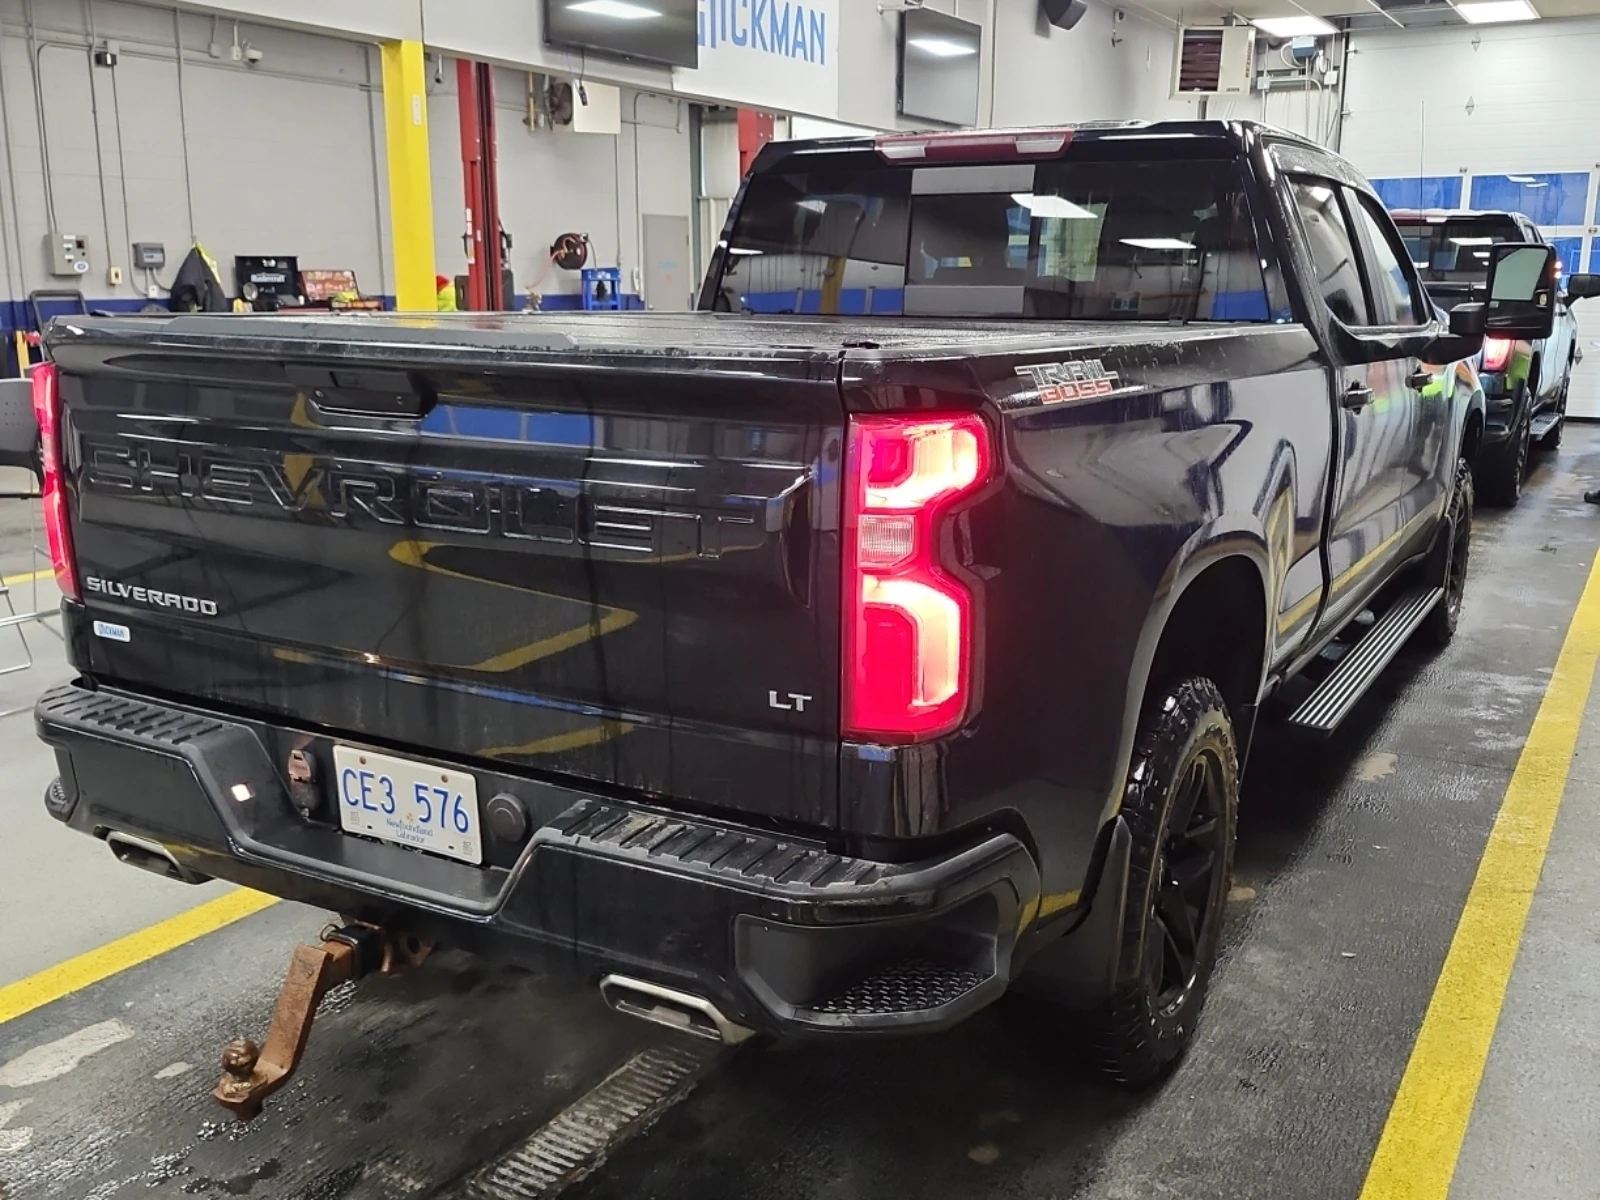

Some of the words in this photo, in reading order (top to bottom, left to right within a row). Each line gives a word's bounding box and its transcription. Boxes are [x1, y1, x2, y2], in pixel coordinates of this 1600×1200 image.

[1014, 359, 1119, 388] TRAIL
[1039, 379, 1113, 404] BOSS
[86, 442, 756, 559] CHEVROLET
[86, 576, 218, 616] SILVERADO
[769, 690, 813, 712] LT
[341, 767, 396, 814] CE3
[414, 783, 470, 834] 576
[386, 817, 434, 837] Newfoundland
[395, 829, 427, 844] Labrador
